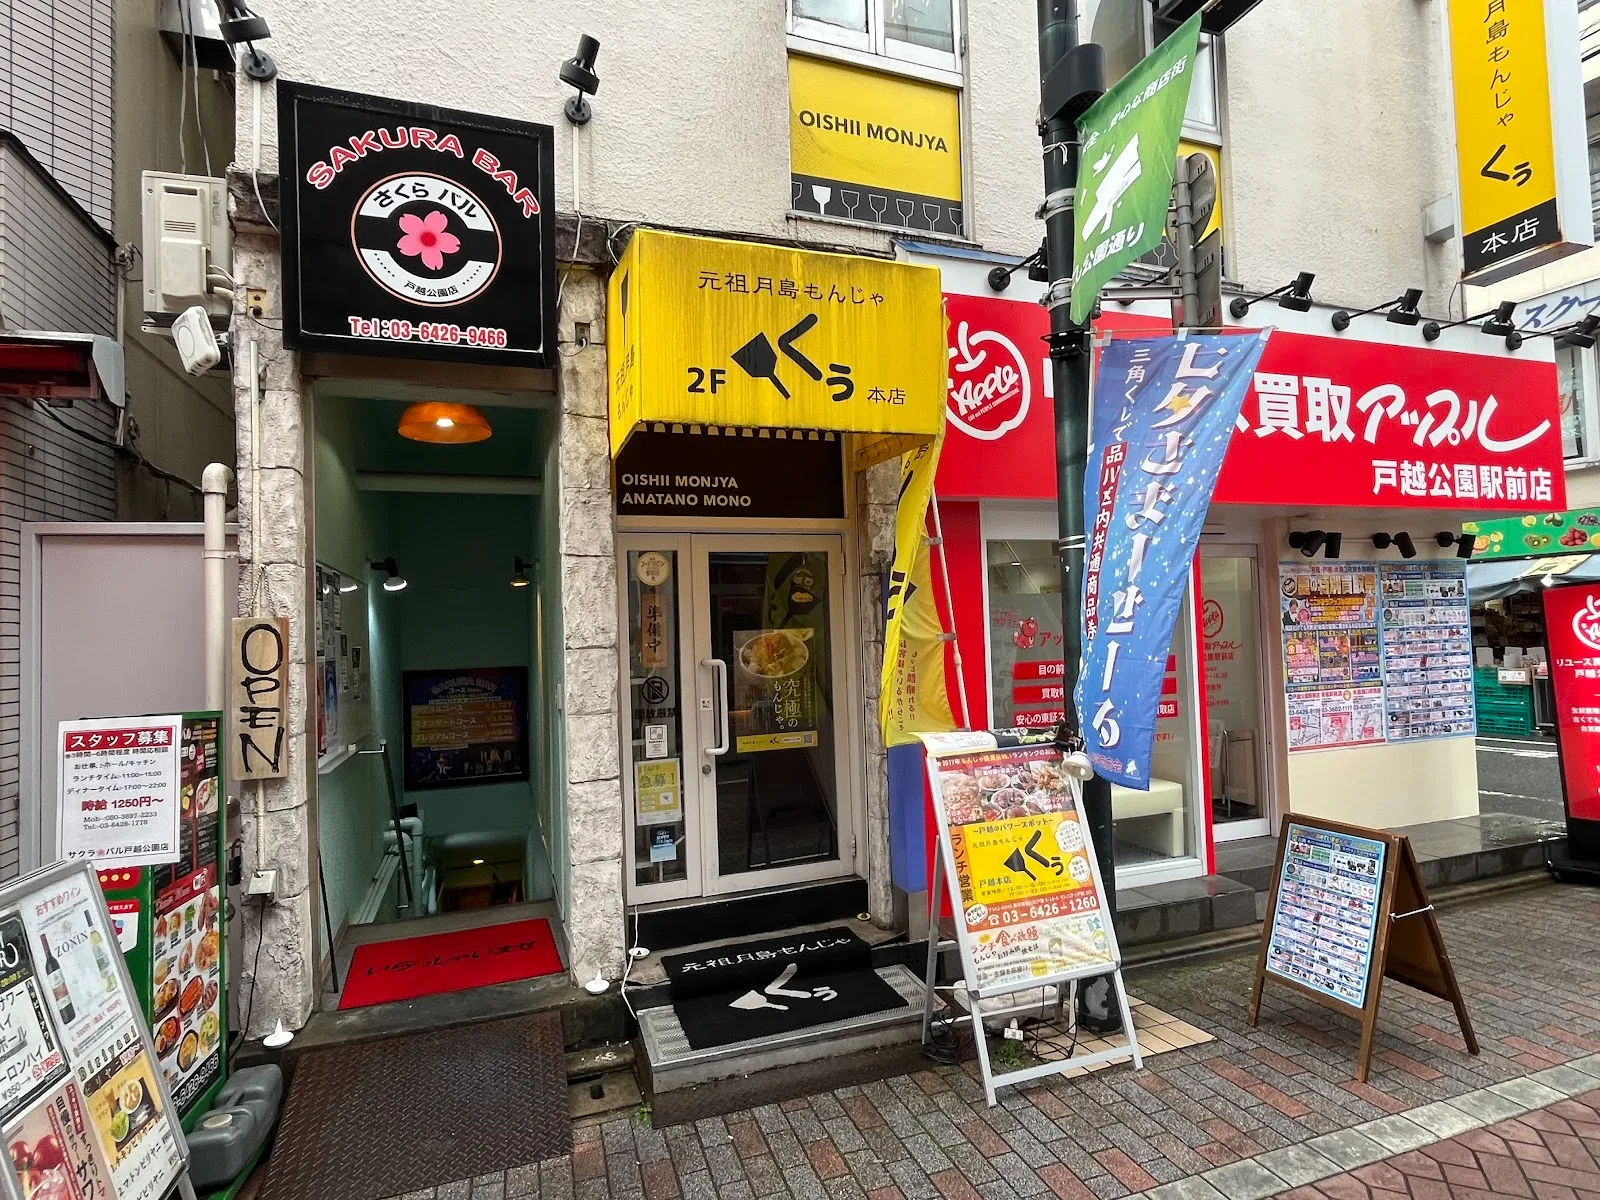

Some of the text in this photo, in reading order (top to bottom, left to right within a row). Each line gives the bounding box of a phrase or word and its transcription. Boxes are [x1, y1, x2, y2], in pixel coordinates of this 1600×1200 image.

[799, 109, 948, 155] OISHII MONJYA
[306, 126, 541, 217] SAKURA BAR
[373, 182, 477, 219] さくら バル
[1480, 217, 1540, 254] 本店
[403, 280, 459, 297] 戸越公園店
[698, 271, 885, 307] 元祖月島もんじゃ
[348, 316, 507, 348] Tel:03-6426-9466
[687, 367, 726, 394] 2F
[867, 386, 906, 405] 本店
[622, 473, 739, 490] OISHII MONJYA
[1371, 459, 1552, 502] 戸越公園駅前店
[621, 492, 752, 508] ANATANO MONO
[783, 679, 801, 727] 究極の
[71, 730, 169, 748] スタッフ募集
[105, 843, 169, 855] バル戸越公園店
[952, 833, 974, 902] ランチ営業
[979, 876, 1012, 889] 戸越本店
[1002, 895, 1097, 923] 03-6426-1260
[681, 938, 852, 974] 元祖月島もんじゃ
